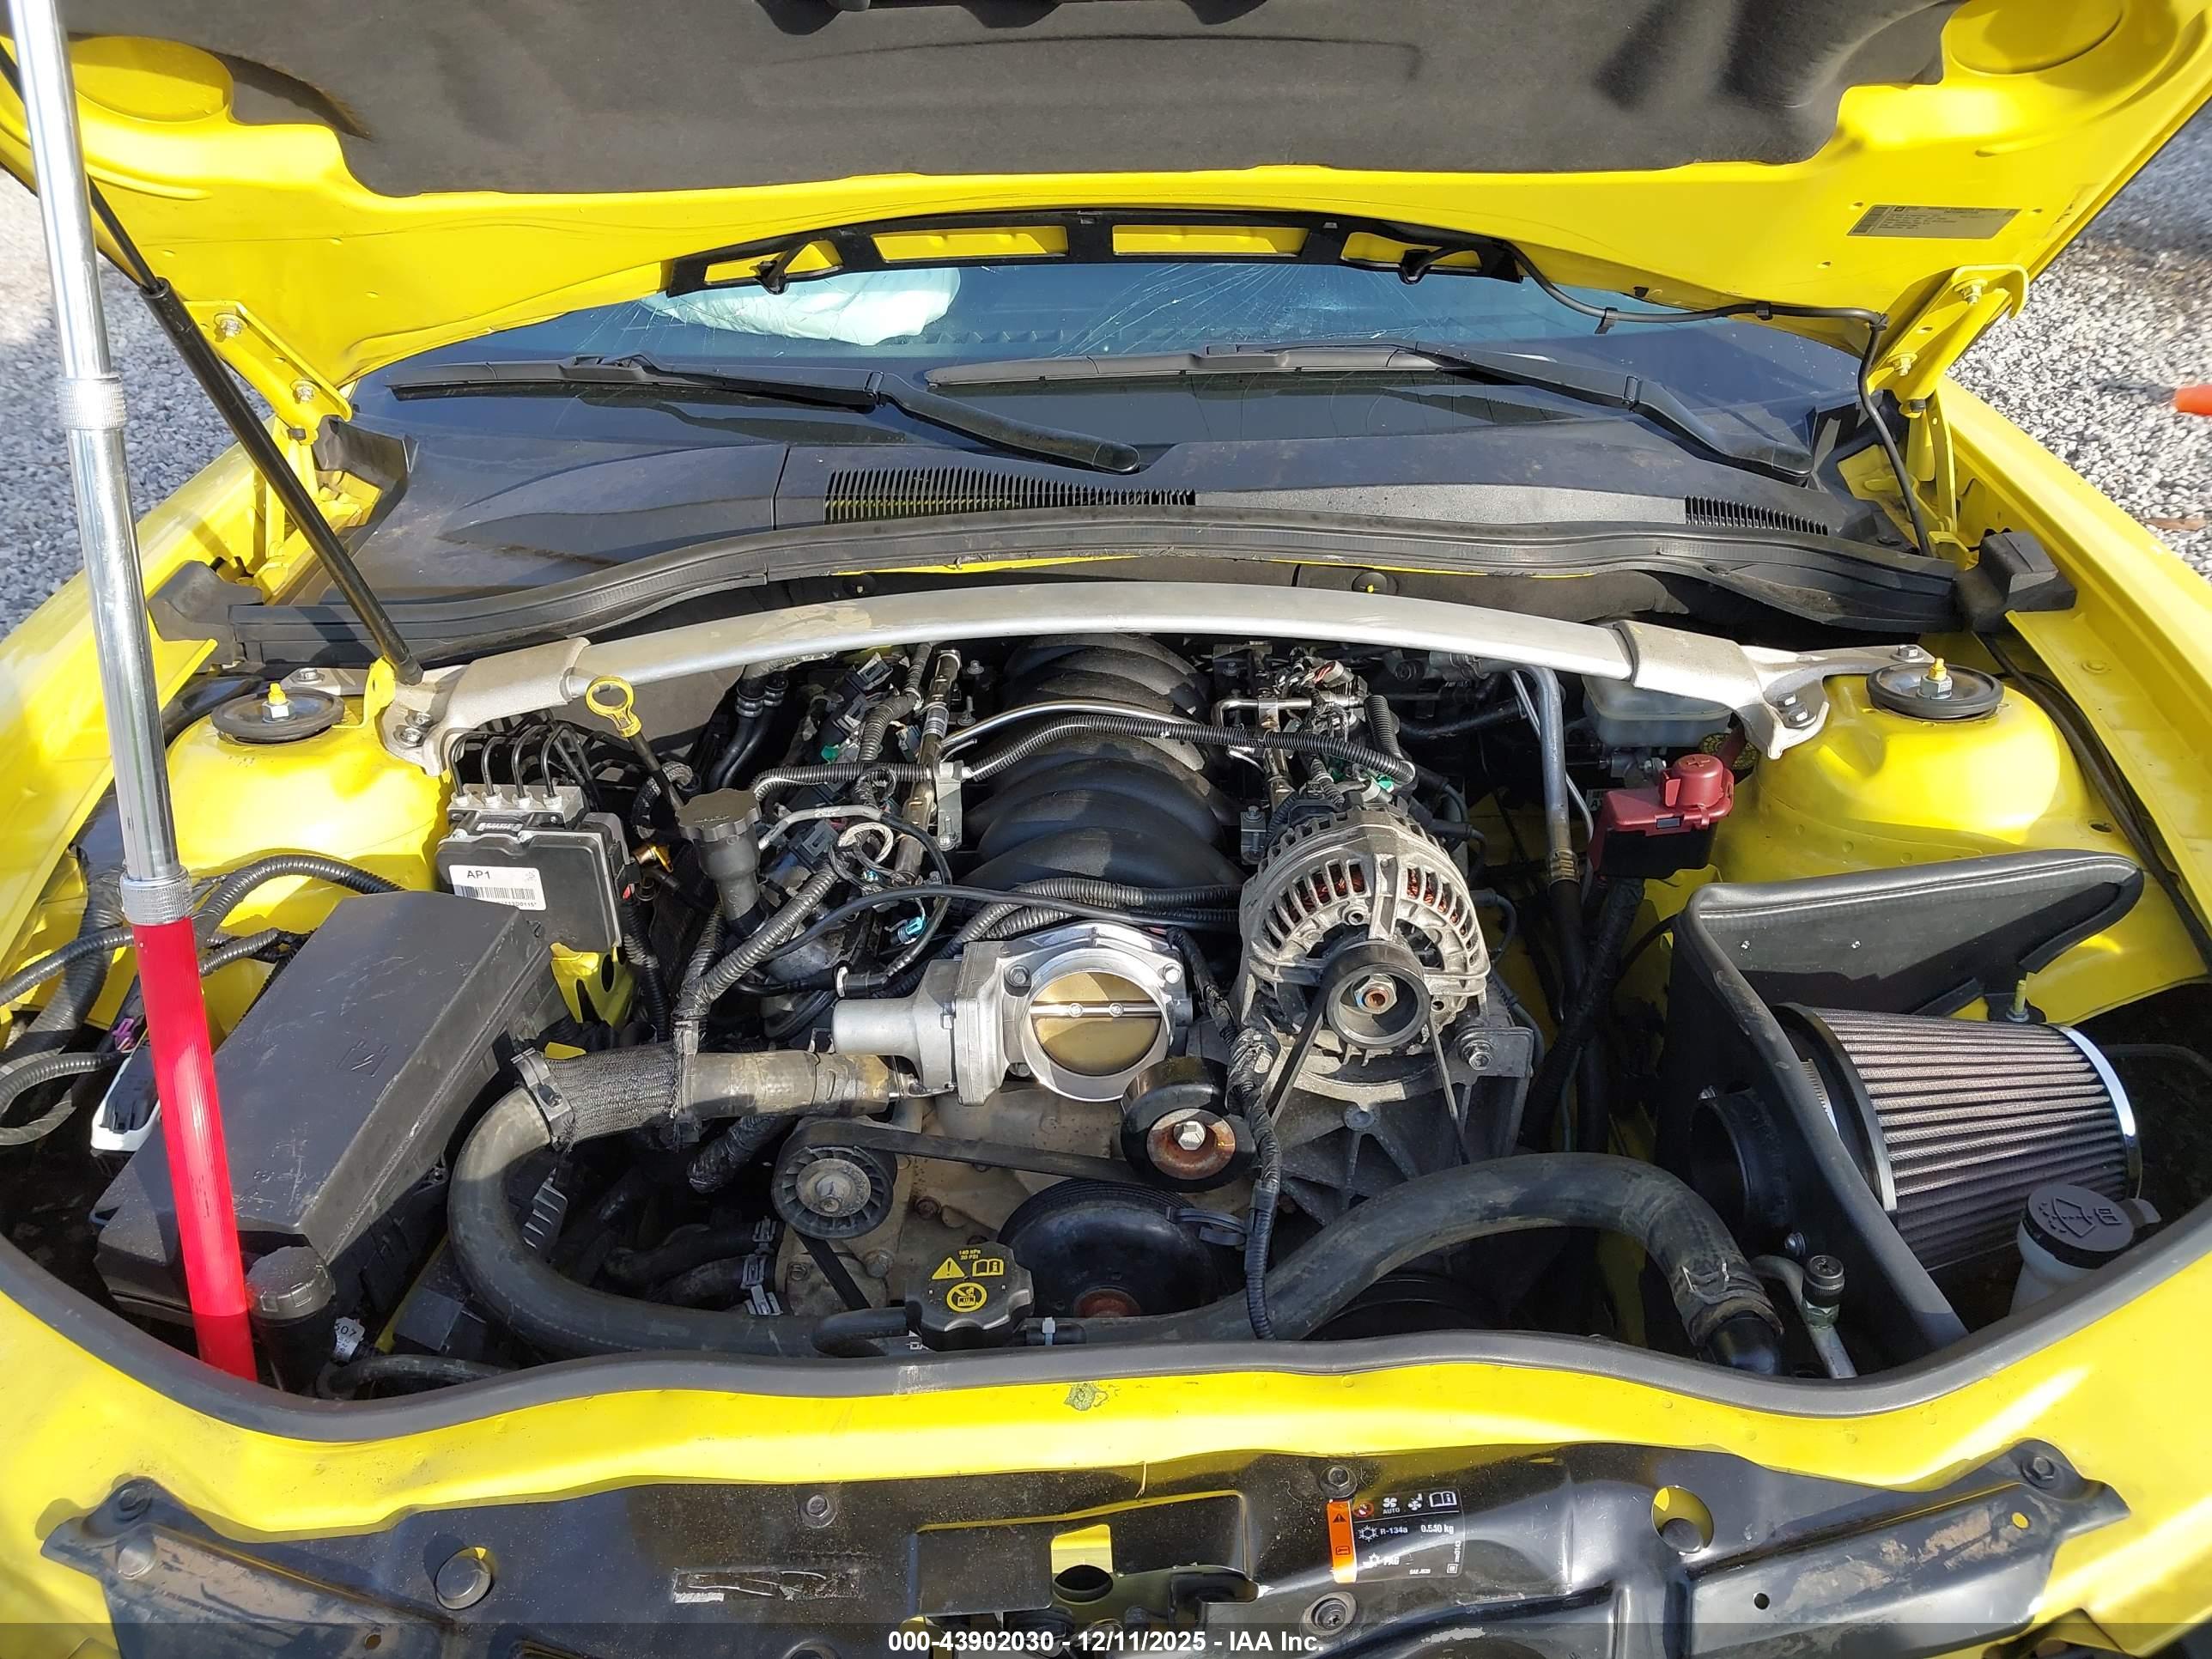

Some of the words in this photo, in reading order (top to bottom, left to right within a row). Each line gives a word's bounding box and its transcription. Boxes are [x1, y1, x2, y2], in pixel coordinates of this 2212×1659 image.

[466, 870, 490, 880] AP1
[1382, 1506, 1401, 1515] AUTO
[1380, 1526, 1408, 1535] R-134a
[1443, 1523, 1455, 1535] kg
